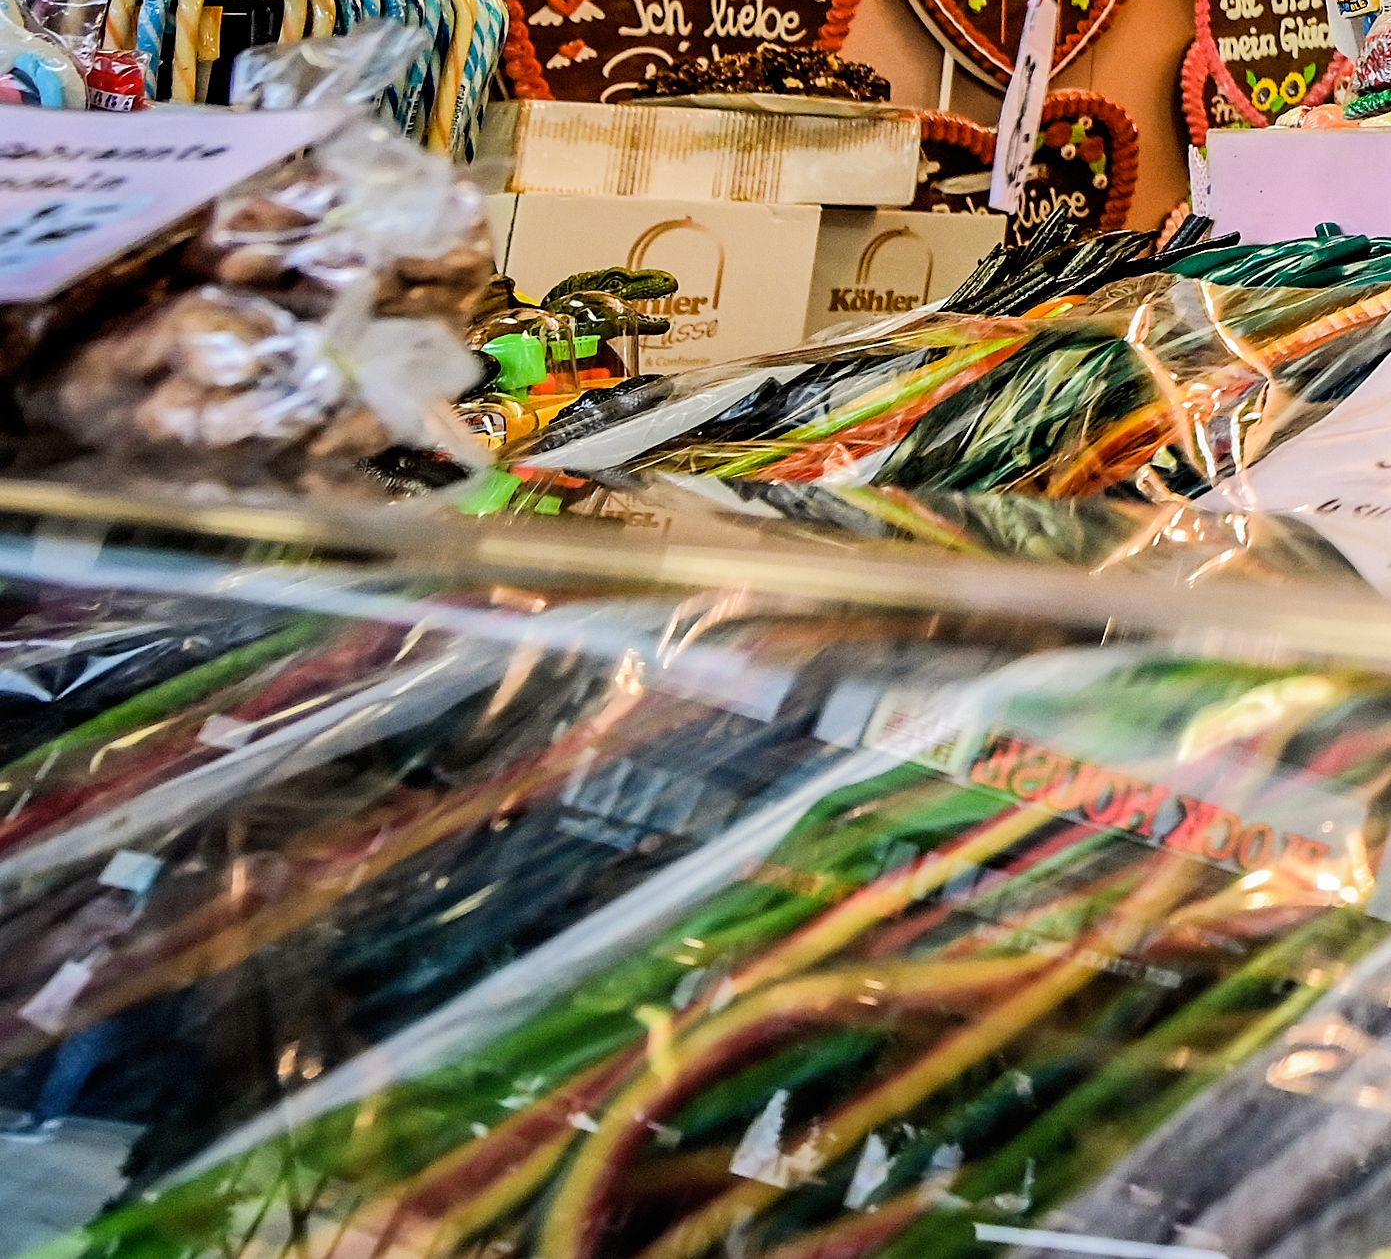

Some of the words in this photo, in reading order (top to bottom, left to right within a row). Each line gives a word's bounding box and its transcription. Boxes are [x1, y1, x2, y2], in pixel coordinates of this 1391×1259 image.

[1217, 26, 1278, 62] mein
[1279, 15, 1336, 60] Glüc
[1012, 188, 1090, 229] liebe
[631, 295, 708, 316] hler
[829, 287, 919, 314] Köhler
